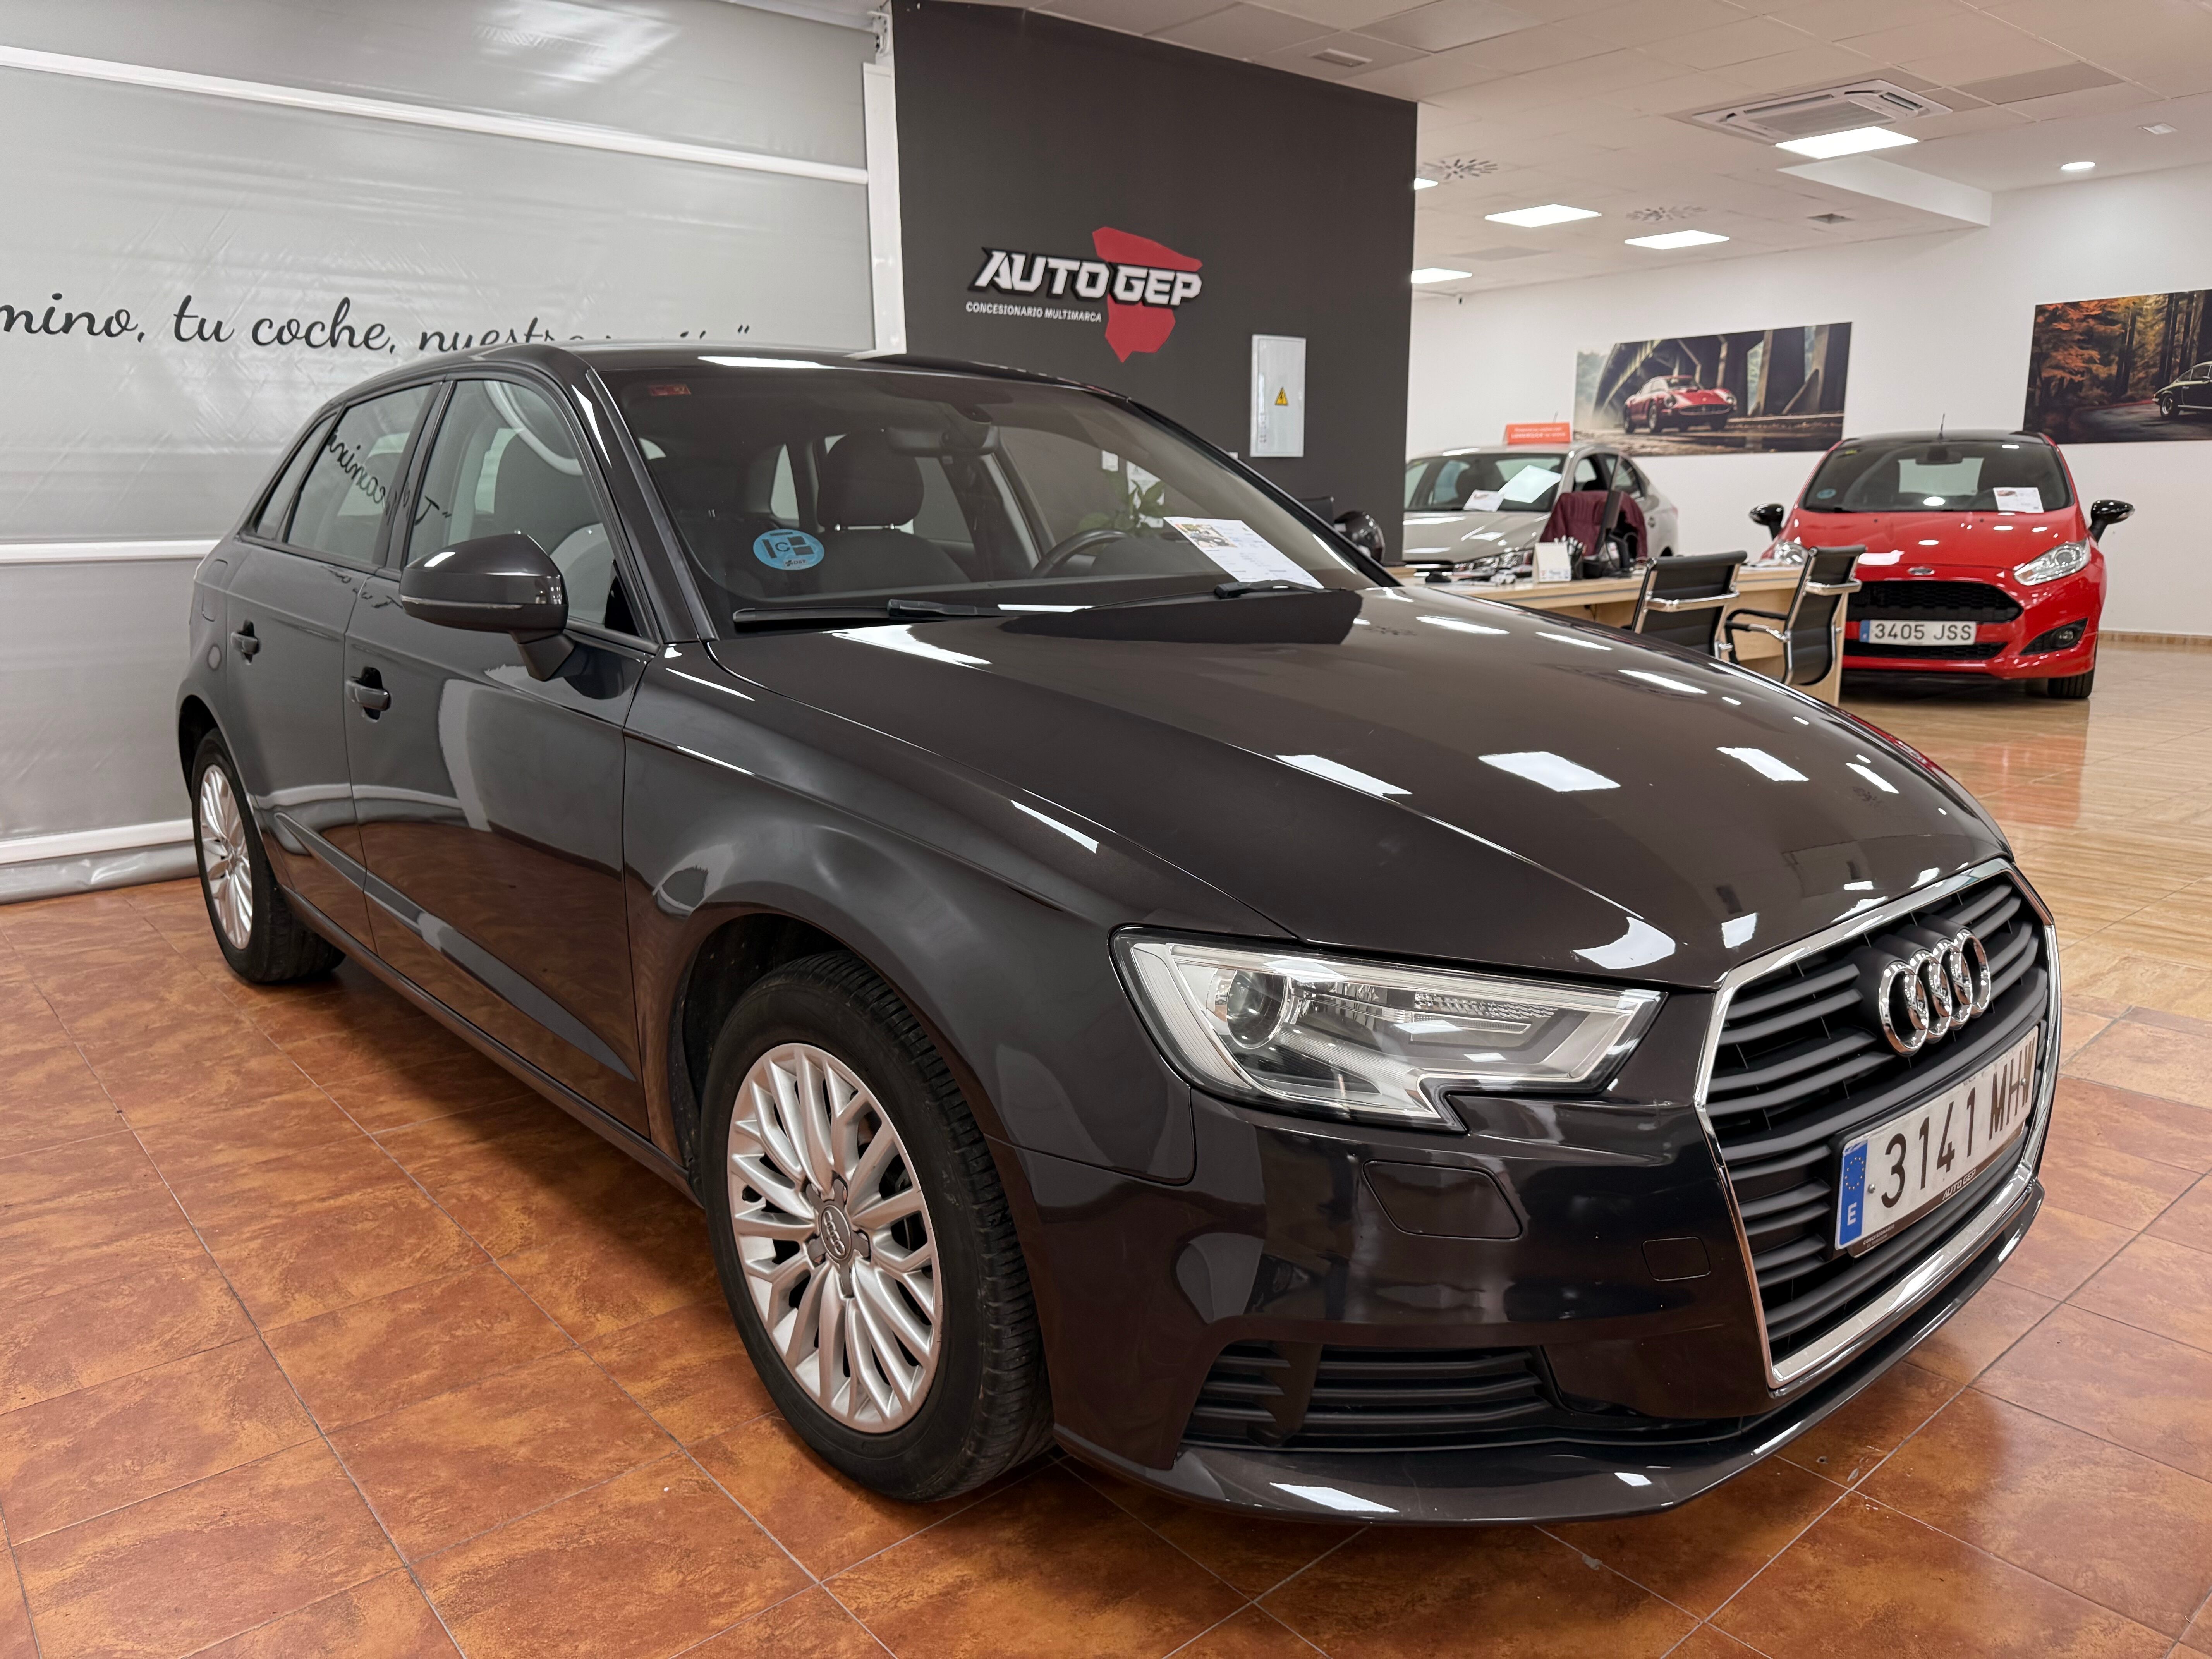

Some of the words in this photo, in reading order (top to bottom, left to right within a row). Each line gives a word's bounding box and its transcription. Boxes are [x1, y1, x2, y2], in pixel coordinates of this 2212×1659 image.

[965, 301, 1043, 318] CONCESIONARIO
[1044, 307, 1102, 323] MULTIMARCA
[173, 295, 235, 342] tu
[251, 297, 396, 354] coche,
[775, 542, 790, 552] C
[1874, 623, 1925, 640] 3405
[1933, 624, 1972, 641] JSS
[1881, 1087, 1975, 1209] 3141
[1989, 1036, 2035, 1141] MHW
[1847, 1202, 1857, 1226] E
